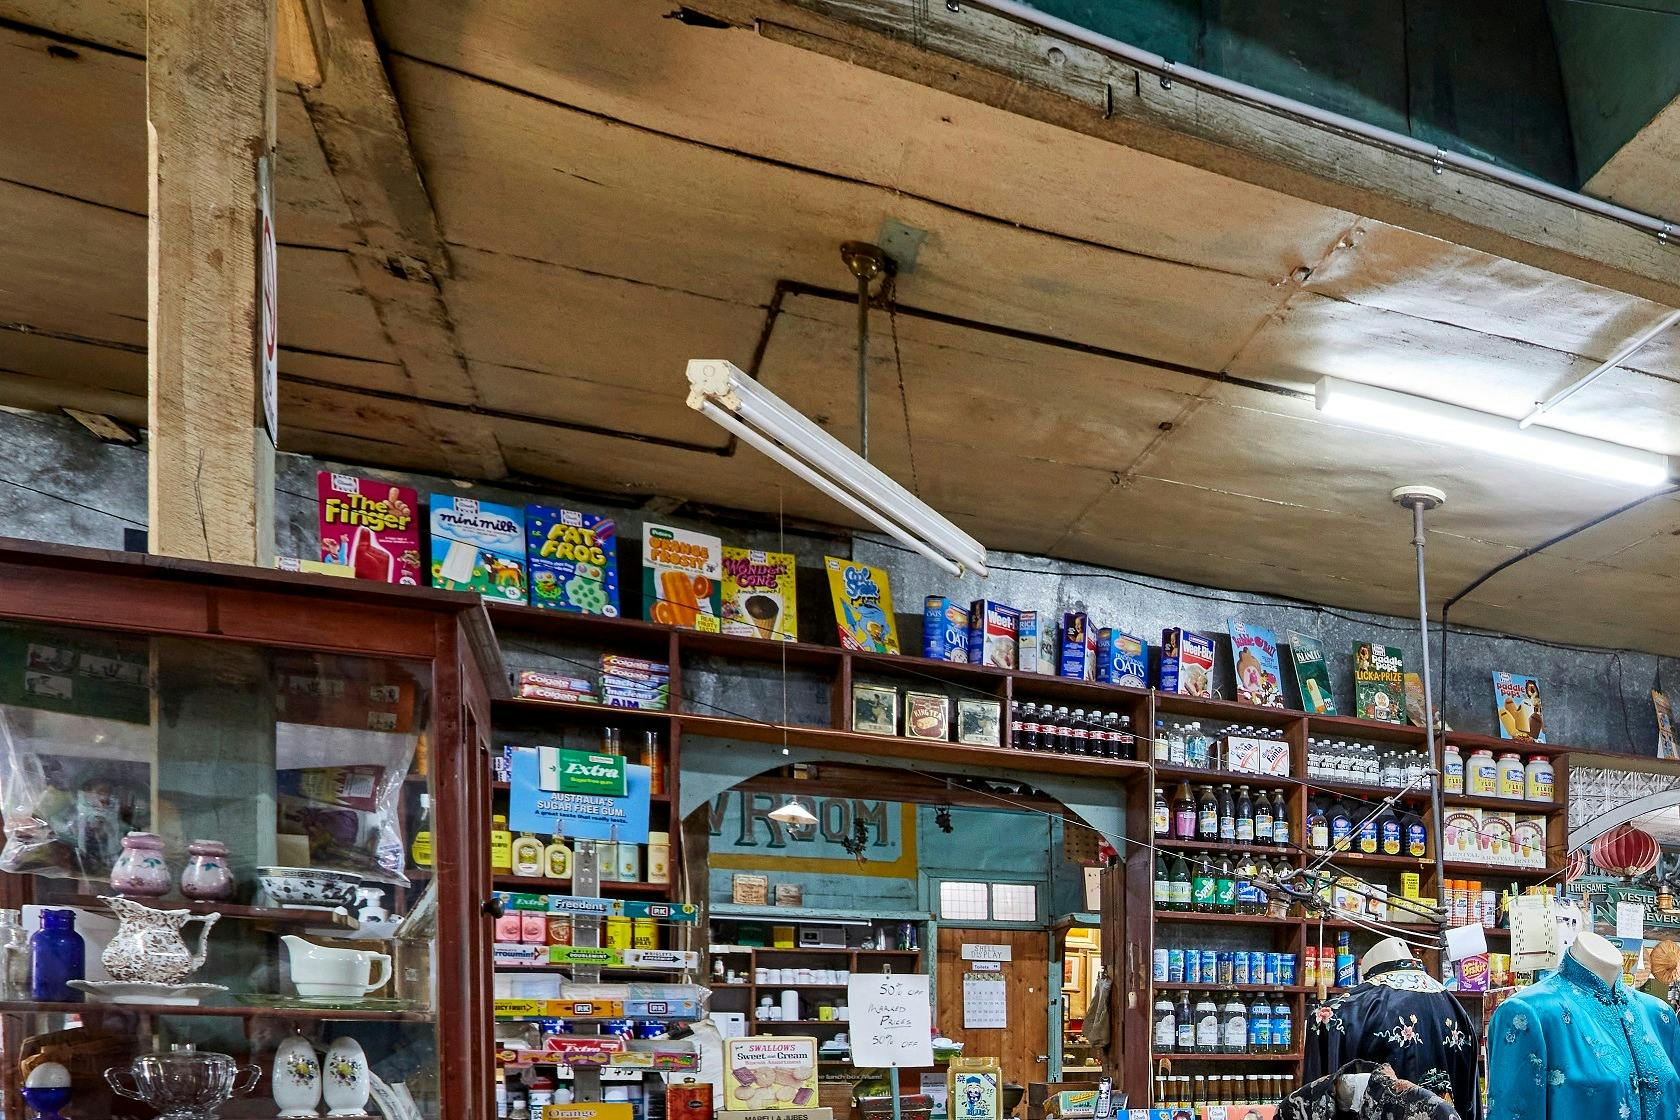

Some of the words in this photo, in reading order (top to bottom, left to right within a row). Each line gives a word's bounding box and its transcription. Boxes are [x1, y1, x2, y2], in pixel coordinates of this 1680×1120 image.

[347, 493, 388, 514] The
[325, 498, 411, 532] Finger
[440, 511, 477, 527] mini
[478, 517, 518, 534] milk
[546, 523, 596, 547] FAT
[540, 539, 607, 565] FROG
[649, 537, 709, 559] ORANGE
[650, 549, 708, 570] FROSTY
[736, 573, 778, 589] CONE
[988, 610, 1019, 631] Weet-B
[1183, 641, 1213, 660] Weet-Bix
[609, 658, 649, 669] Colgate
[1113, 658, 1145, 677] OATS
[609, 668, 649, 679] Colgate
[528, 674, 570, 688] Colgate
[536, 688, 578, 701] Colgate
[606, 687, 652, 698] macleans
[610, 698, 639, 708] AIM
[564, 763, 620, 778] Extra
[551, 793, 614, 806] AUSTRALIA'S
[537, 800, 572, 810] SUGAR
[574, 804, 600, 814] FREE
[602, 806, 627, 817] GUM.
[1570, 884, 1586, 892] THE
[1587, 884, 1607, 892] SAME
[556, 900, 606, 912] Freedent
[971, 951, 1002, 959] DISPLAY
[749, 1044, 796, 1052] SWALLOWS
[737, 1052, 766, 1060] Sweet
[777, 1052, 808, 1060] Cream
[548, 1109, 597, 1117] Orange
